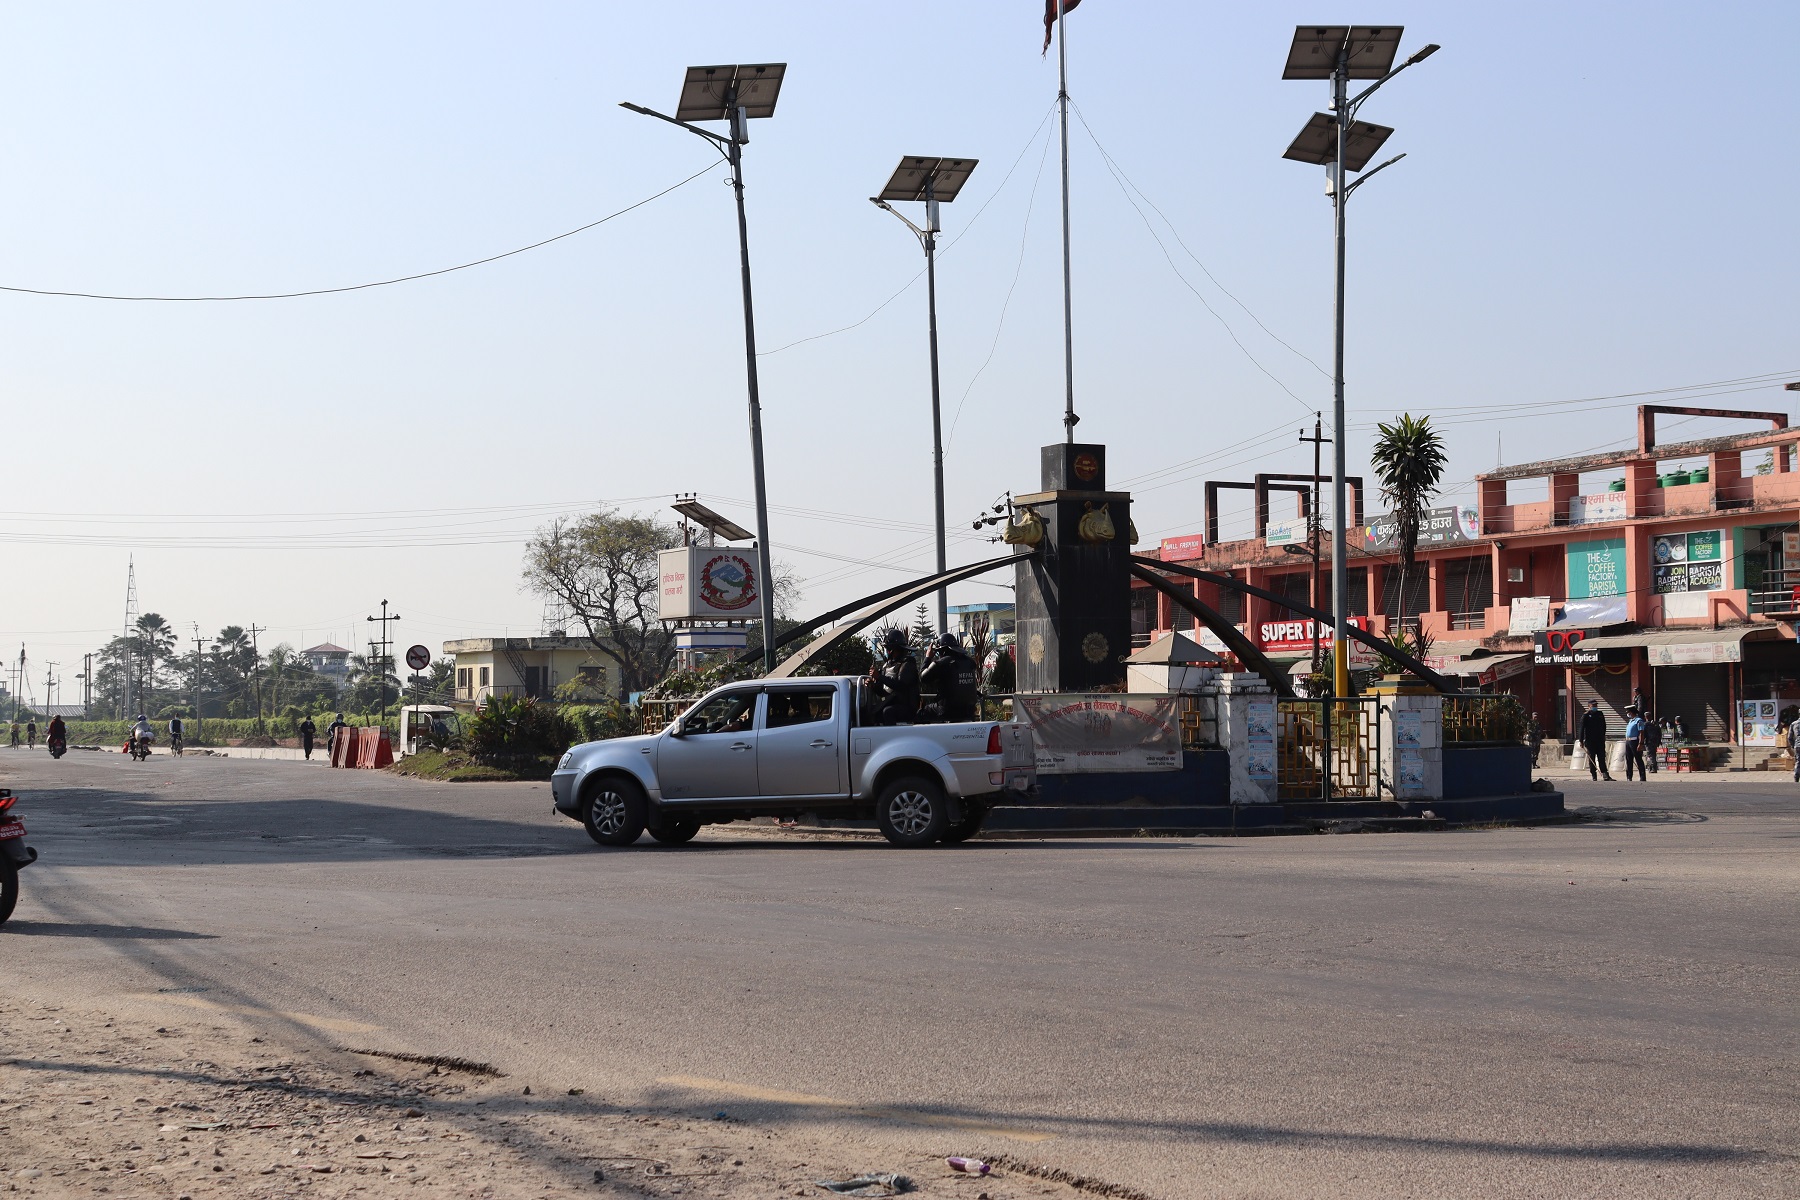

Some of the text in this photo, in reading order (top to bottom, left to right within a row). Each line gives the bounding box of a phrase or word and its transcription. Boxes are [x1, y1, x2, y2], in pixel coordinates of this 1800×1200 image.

[1580, 494, 1605, 505] चश्मा
[1431, 517, 1452, 529] हाउस
[1587, 552, 1600, 563] THE
[1587, 562, 1616, 573] COFFEE
[1671, 567, 1685, 575] JOIN
[1689, 566, 1721, 578] BARISTA
[1588, 572, 1614, 581] FACTORY
[1658, 575, 1686, 586] BARISTA
[1690, 576, 1722, 586] ACADEMY
[1589, 581, 1617, 591] BARISTA
[1261, 621, 1304, 641] SUPER
[1534, 653, 1598, 663] Clear Vision Optical
